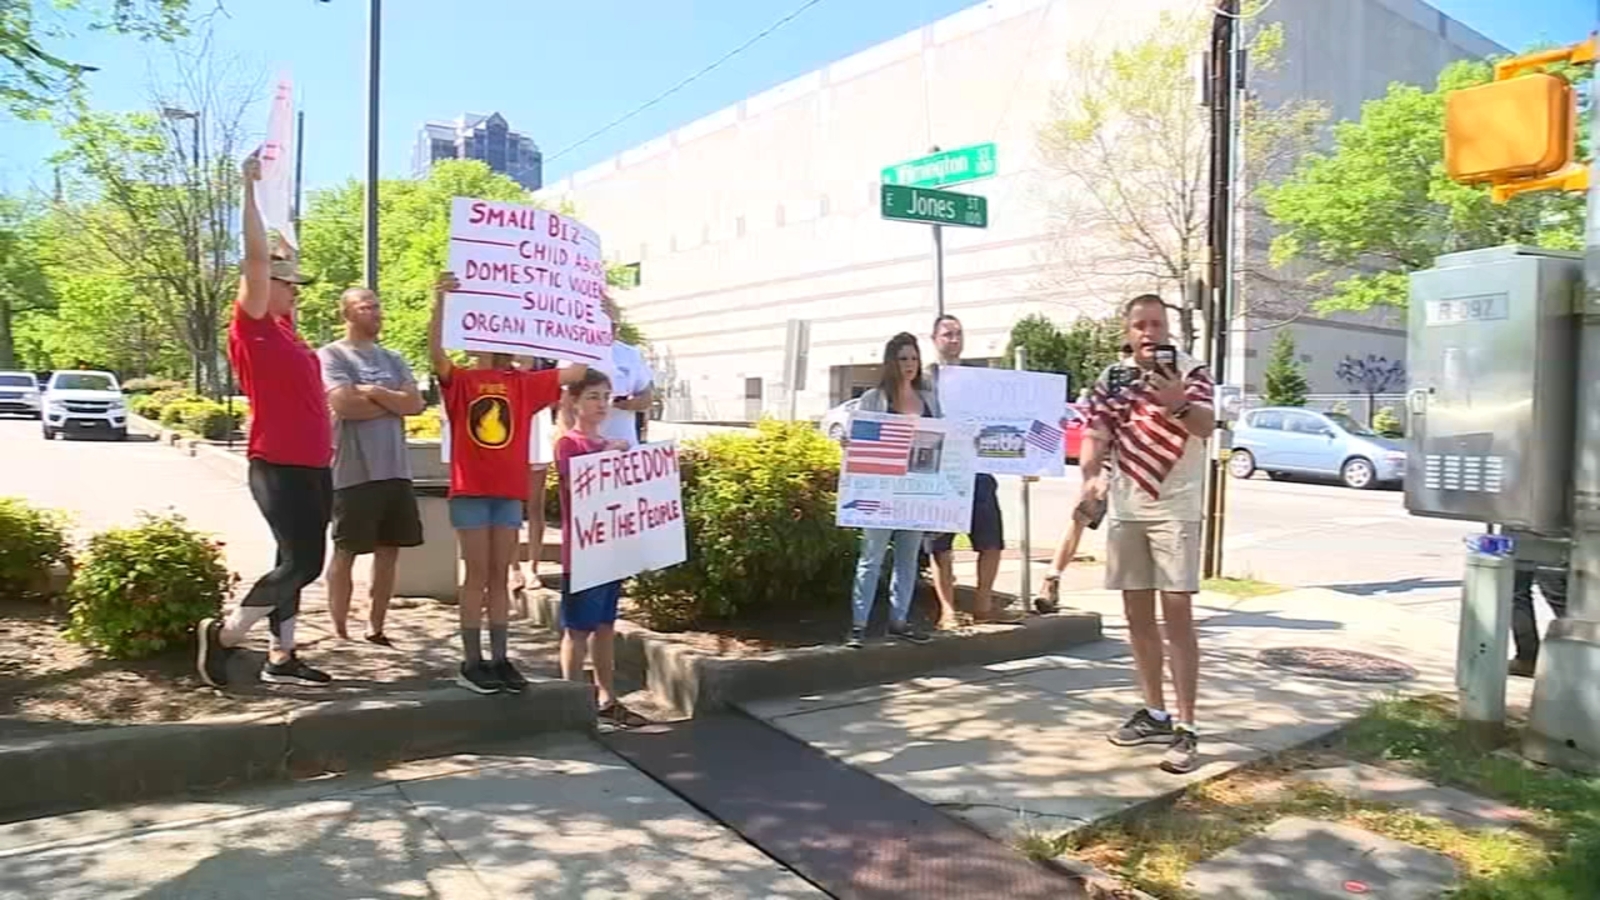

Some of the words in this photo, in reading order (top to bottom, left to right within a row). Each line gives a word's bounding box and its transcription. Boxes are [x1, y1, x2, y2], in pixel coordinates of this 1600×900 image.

[886, 192, 894, 206] E
[906, 189, 956, 219] Jones
[967, 197, 979, 210] ST
[469, 202, 535, 231] SMALL
[548, 213, 581, 245] BIZ
[519, 240, 568, 266] CHILD
[465, 259, 562, 289] DOMESTIC
[522, 291, 596, 324] SUICIDE
[461, 312, 526, 335] ORGAN
[574, 445, 680, 499] #FREEDOM
[574, 511, 606, 550] WE
[606, 503, 636, 539] THE
[637, 497, 681, 531] PEOPLE
